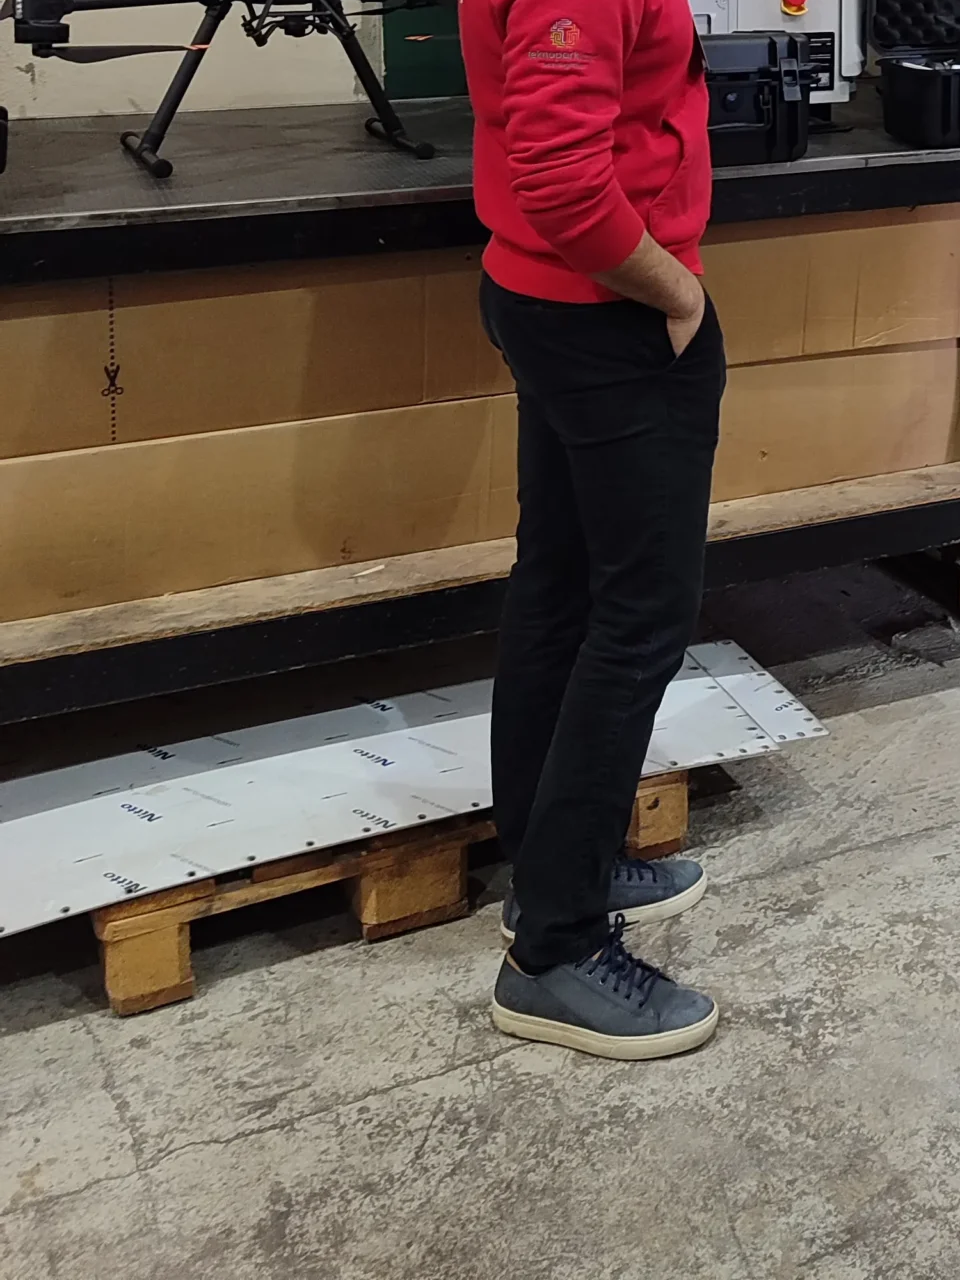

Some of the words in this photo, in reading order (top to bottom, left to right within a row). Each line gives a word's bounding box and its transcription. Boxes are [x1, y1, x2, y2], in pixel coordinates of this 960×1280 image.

[353, 748, 395, 767] Nitto
[120, 802, 163, 823] Nitto
[352, 808, 397, 829] Nitto
[103, 871, 148, 894] Nitto
